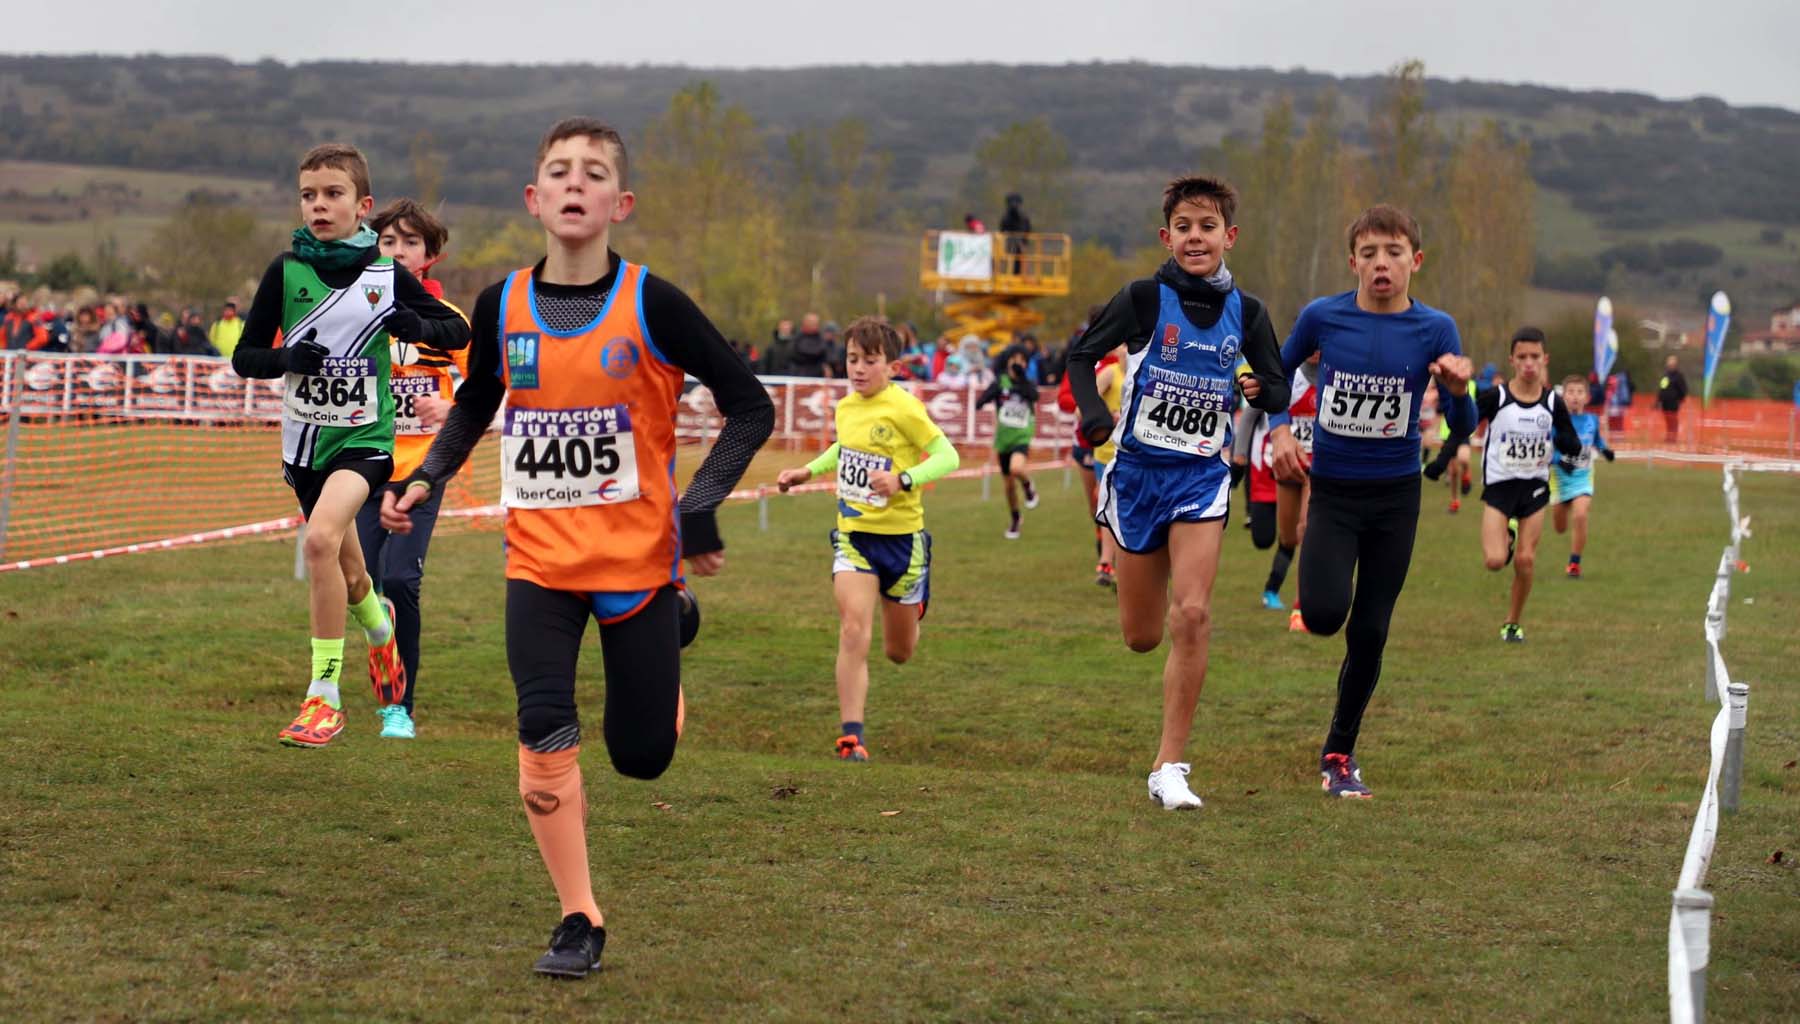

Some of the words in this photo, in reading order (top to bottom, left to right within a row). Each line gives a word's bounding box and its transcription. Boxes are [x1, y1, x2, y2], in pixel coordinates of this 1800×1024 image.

[322, 357, 369, 368] TACIÓN
[320, 367, 369, 376] RGOS
[1149, 365, 1197, 387] UNIVERSIDAD
[1199, 377, 1209, 389] DE
[1335, 371, 1405, 385] DIPUTACIÓN
[389, 376, 433, 386] UTACIÓN
[394, 384, 433, 394] RGOS
[1333, 380, 1405, 392] BURGOS
[295, 376, 368, 407] 4364
[1155, 381, 1224, 402] DIPUTACIÓN
[392, 393, 431, 418] 28
[1152, 390, 1223, 411] BURGOS
[1330, 390, 1401, 420] 5773
[514, 408, 616, 423] DIPUTACIÓN
[1147, 401, 1218, 438] 4080
[512, 420, 618, 436] BURGOS
[1328, 419, 1373, 434] iberCaja
[1142, 429, 1188, 447] iberCaja
[514, 436, 621, 479] 4405
[1506, 443, 1546, 459] 4315
[840, 463, 875, 490] 430
[516, 486, 582, 502] iberCaja
